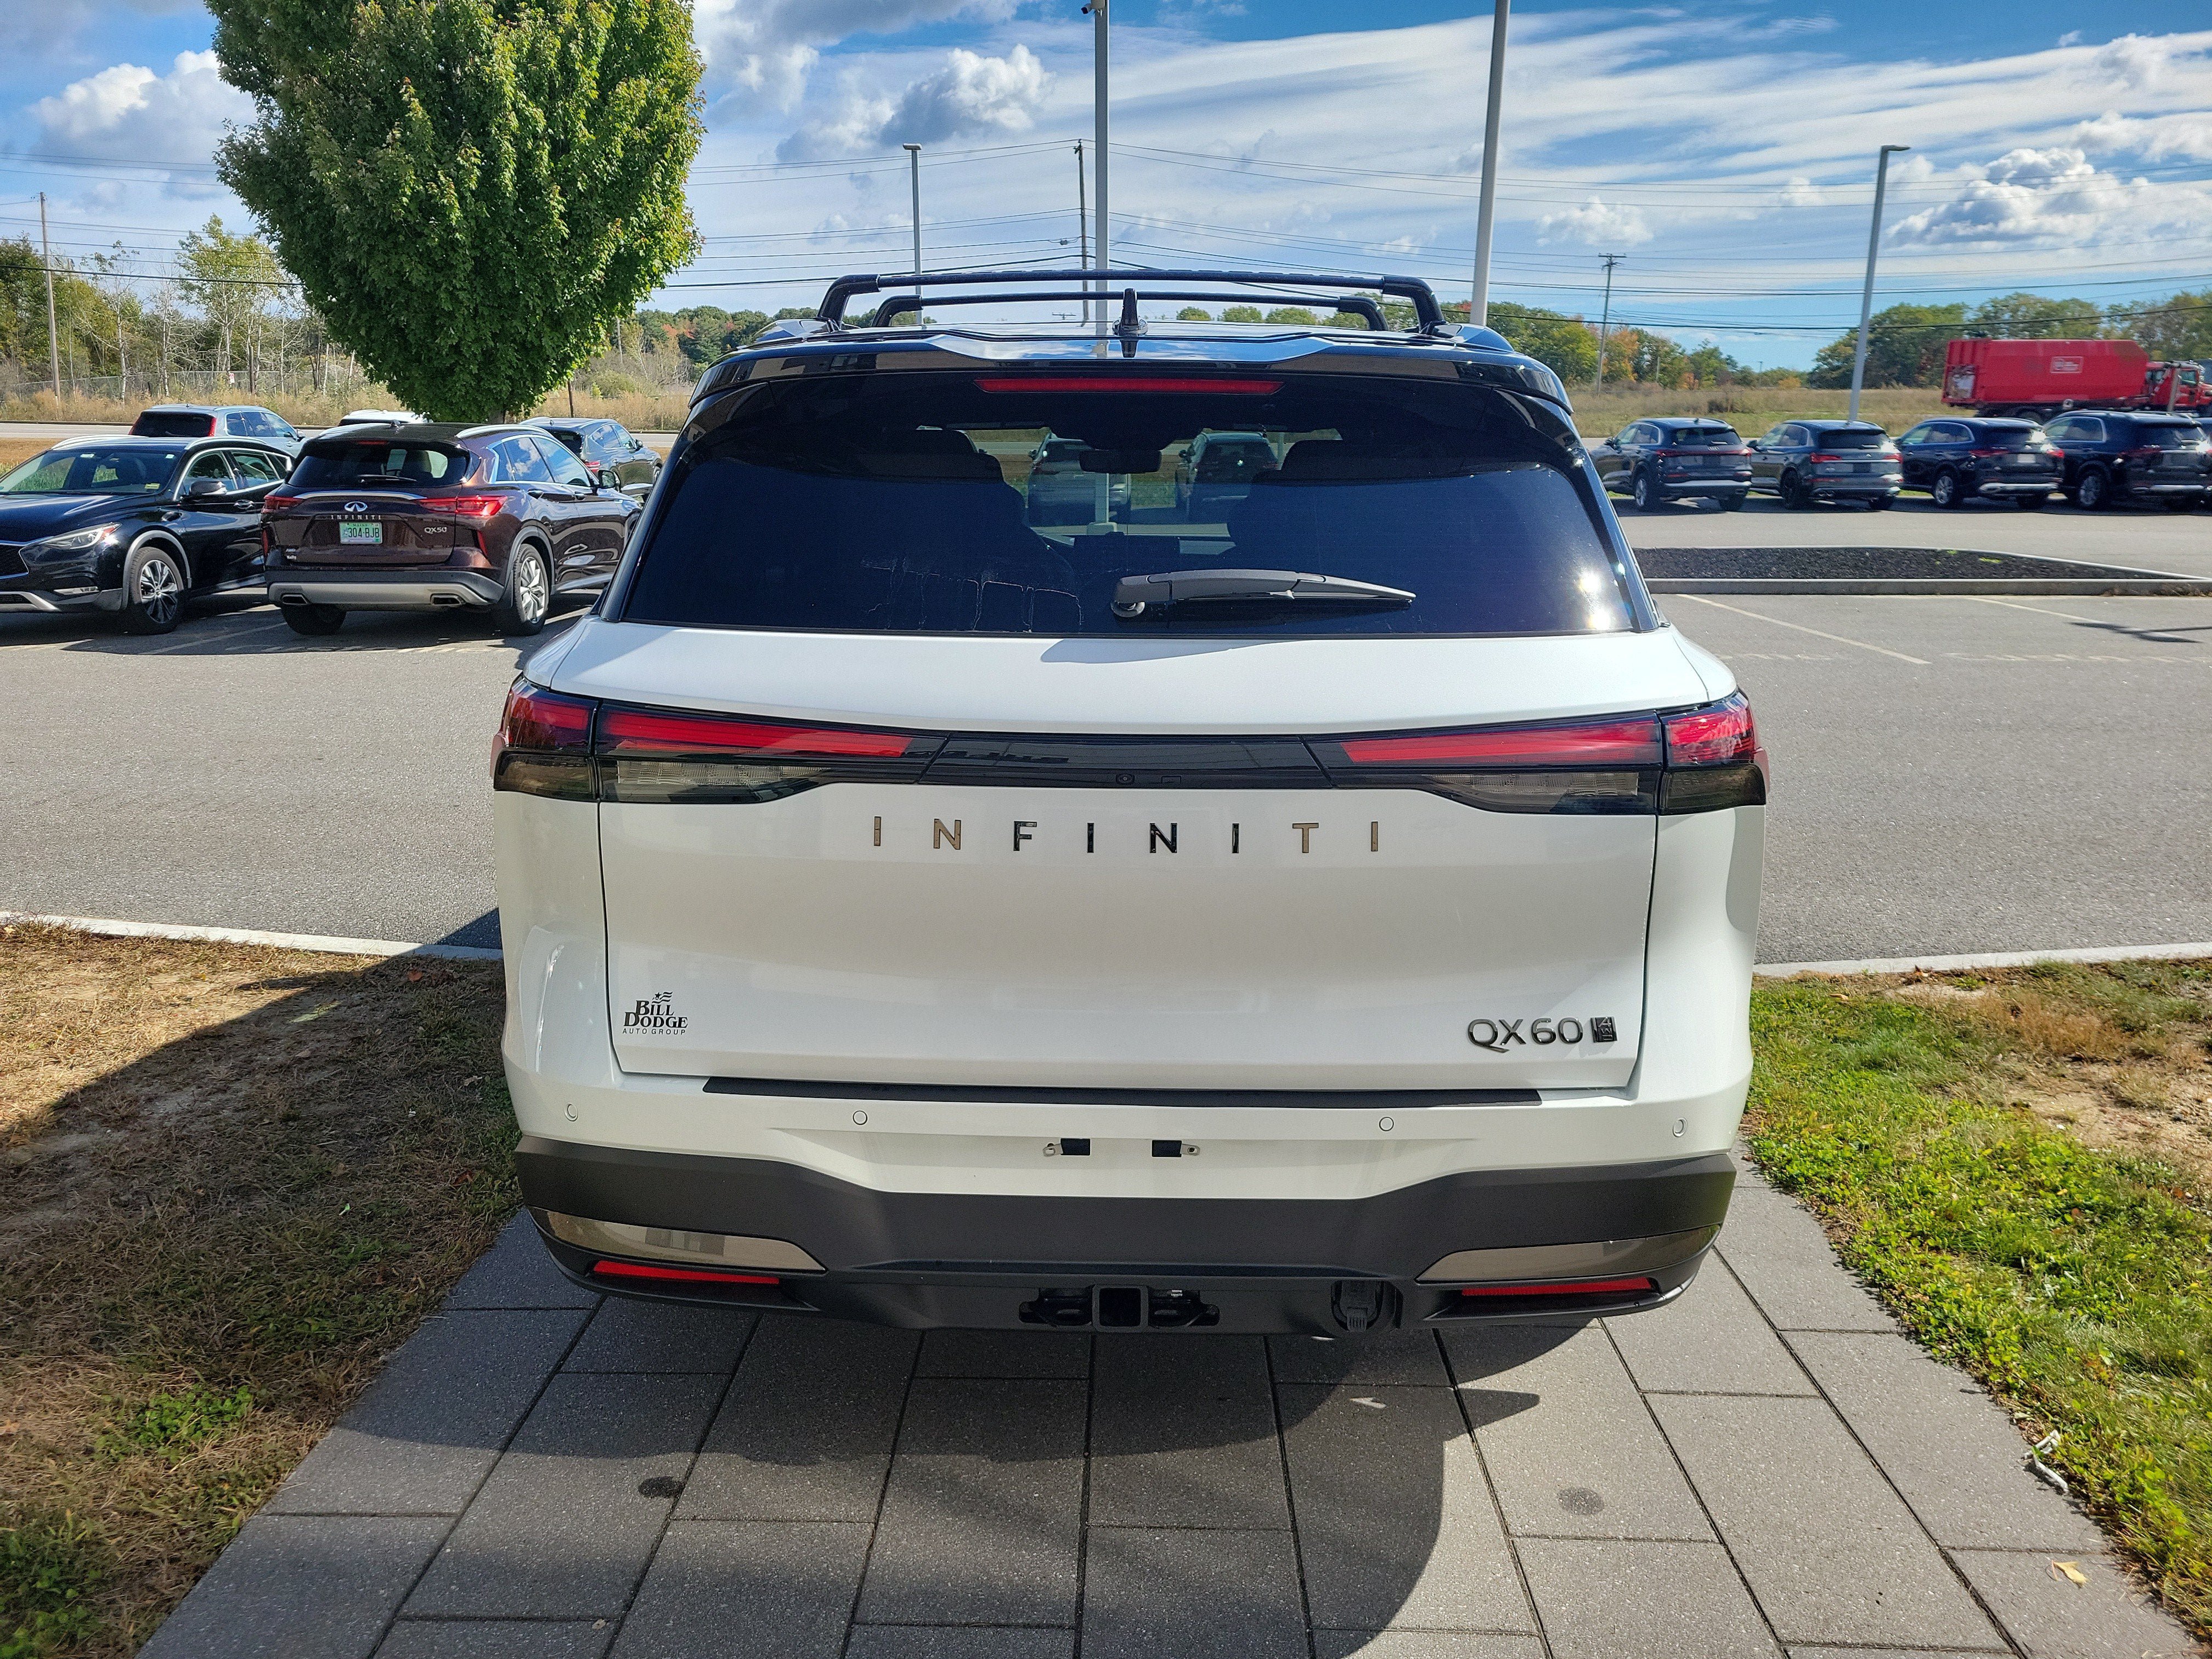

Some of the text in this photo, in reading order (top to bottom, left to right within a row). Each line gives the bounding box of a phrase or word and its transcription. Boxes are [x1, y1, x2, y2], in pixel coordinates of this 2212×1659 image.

[873, 816, 1379, 854] INFINITI
[623, 1012, 689, 1029] DODGE
[636, 1000, 675, 1015] BILL
[1468, 1017, 1584, 1053] QX60
